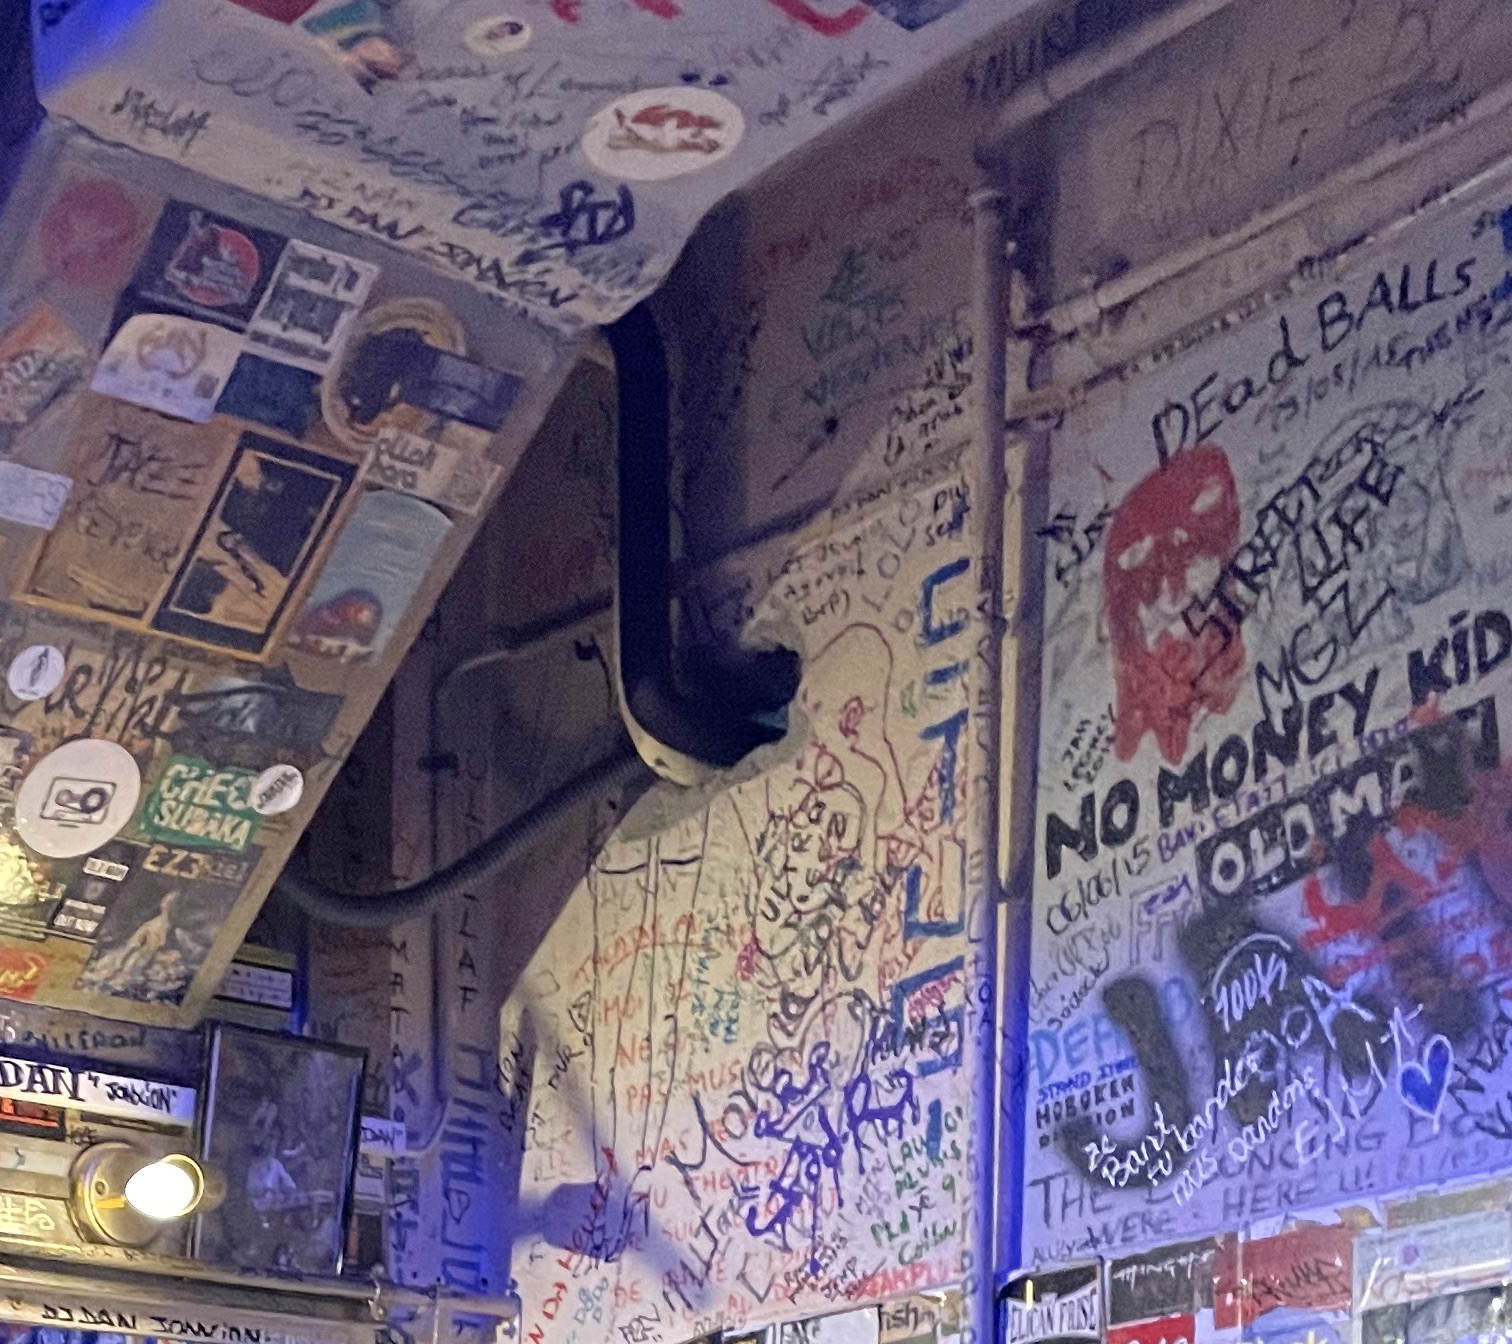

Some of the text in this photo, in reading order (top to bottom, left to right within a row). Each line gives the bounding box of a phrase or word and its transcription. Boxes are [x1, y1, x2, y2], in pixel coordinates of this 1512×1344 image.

[1317, 258, 1476, 352] BALLS
[1046, 779, 1140, 880] NO
[1157, 668, 1382, 828] MONEY
